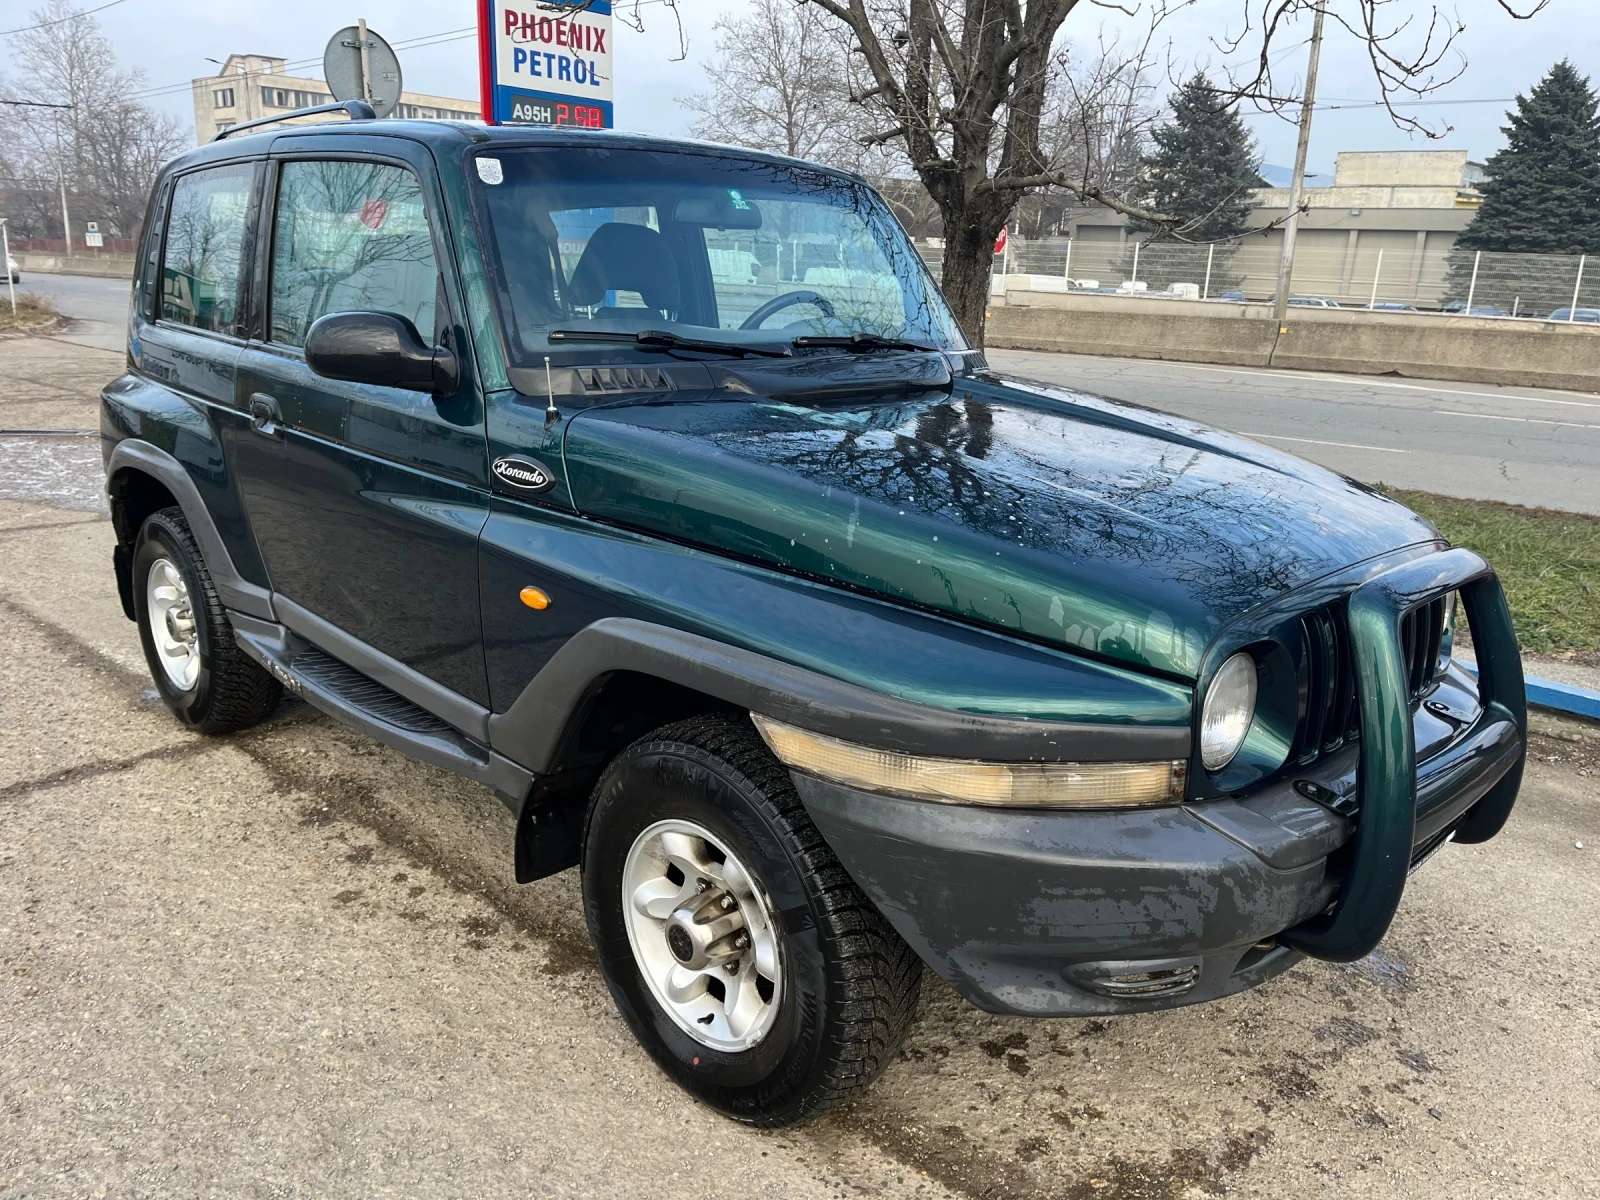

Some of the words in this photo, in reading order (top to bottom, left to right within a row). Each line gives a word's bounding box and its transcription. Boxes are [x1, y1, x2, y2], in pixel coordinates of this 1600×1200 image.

[504, 9, 606, 54] PHOENIX
[513, 47, 600, 87] PETROL
[496, 461, 544, 484] Korando
